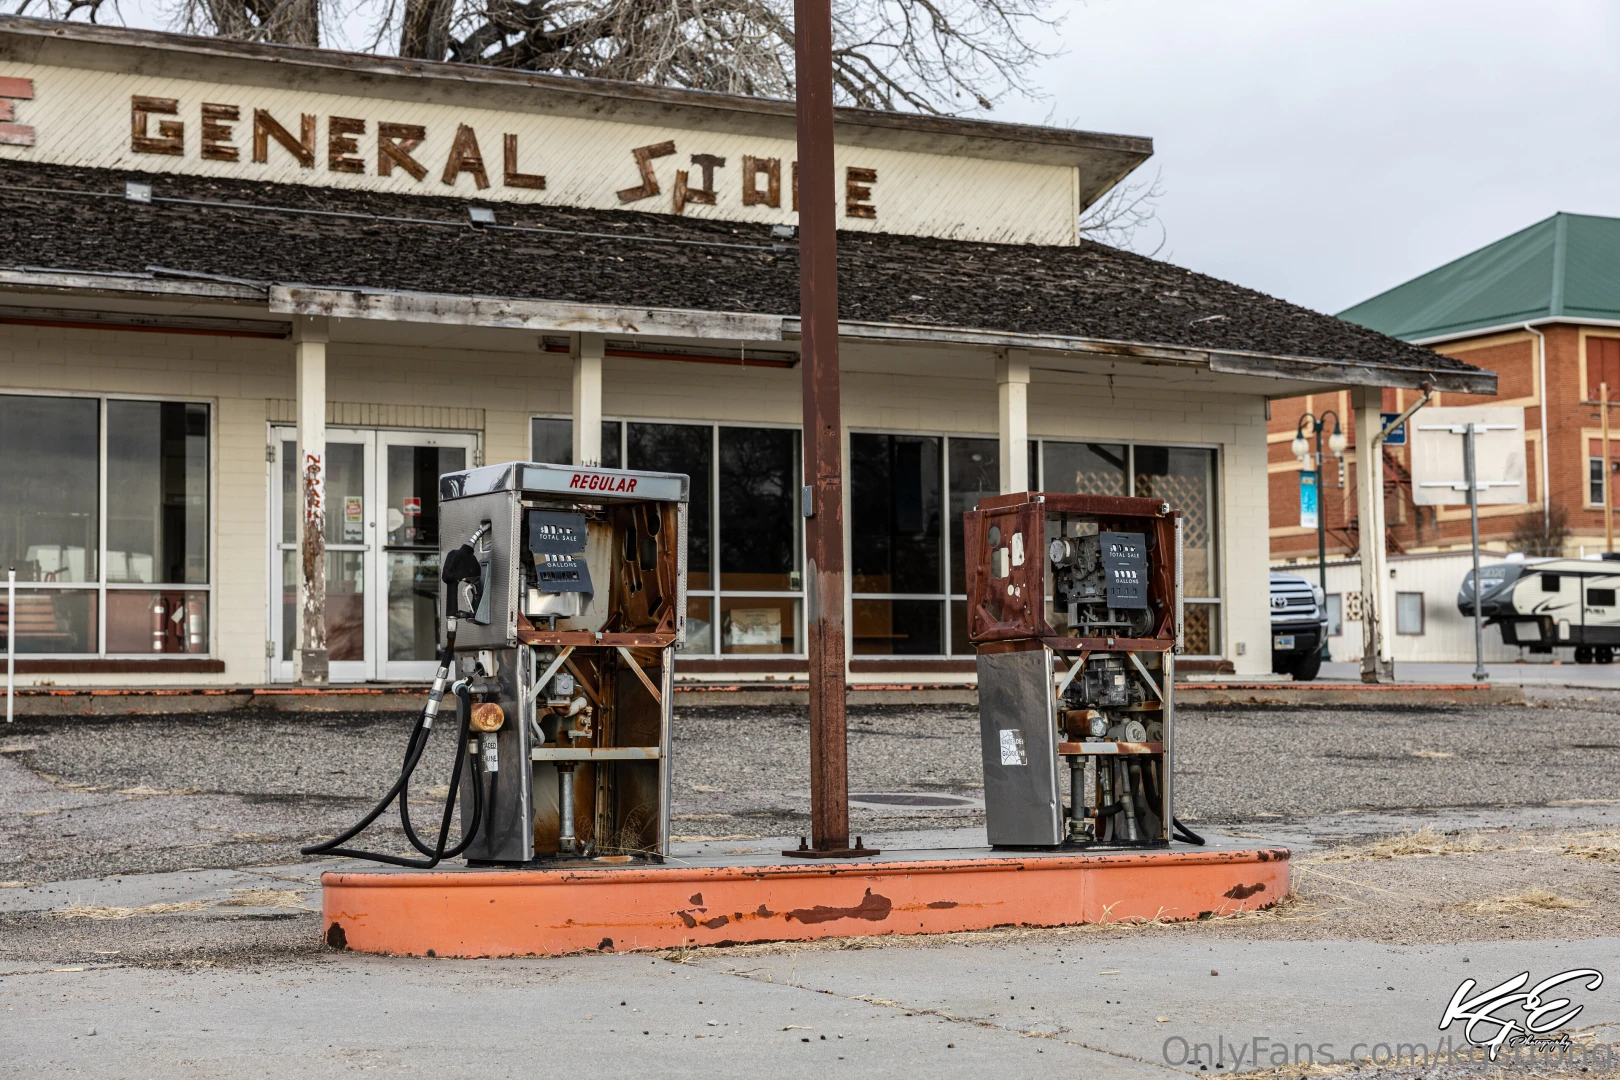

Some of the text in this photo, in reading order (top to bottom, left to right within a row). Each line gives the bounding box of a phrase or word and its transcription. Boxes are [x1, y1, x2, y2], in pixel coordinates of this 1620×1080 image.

[131, 94, 547, 190] GENERAL
[616, 139, 877, 219] STOE
[569, 474, 638, 493] REGULAR
[539, 533, 559, 541] TOTAL
